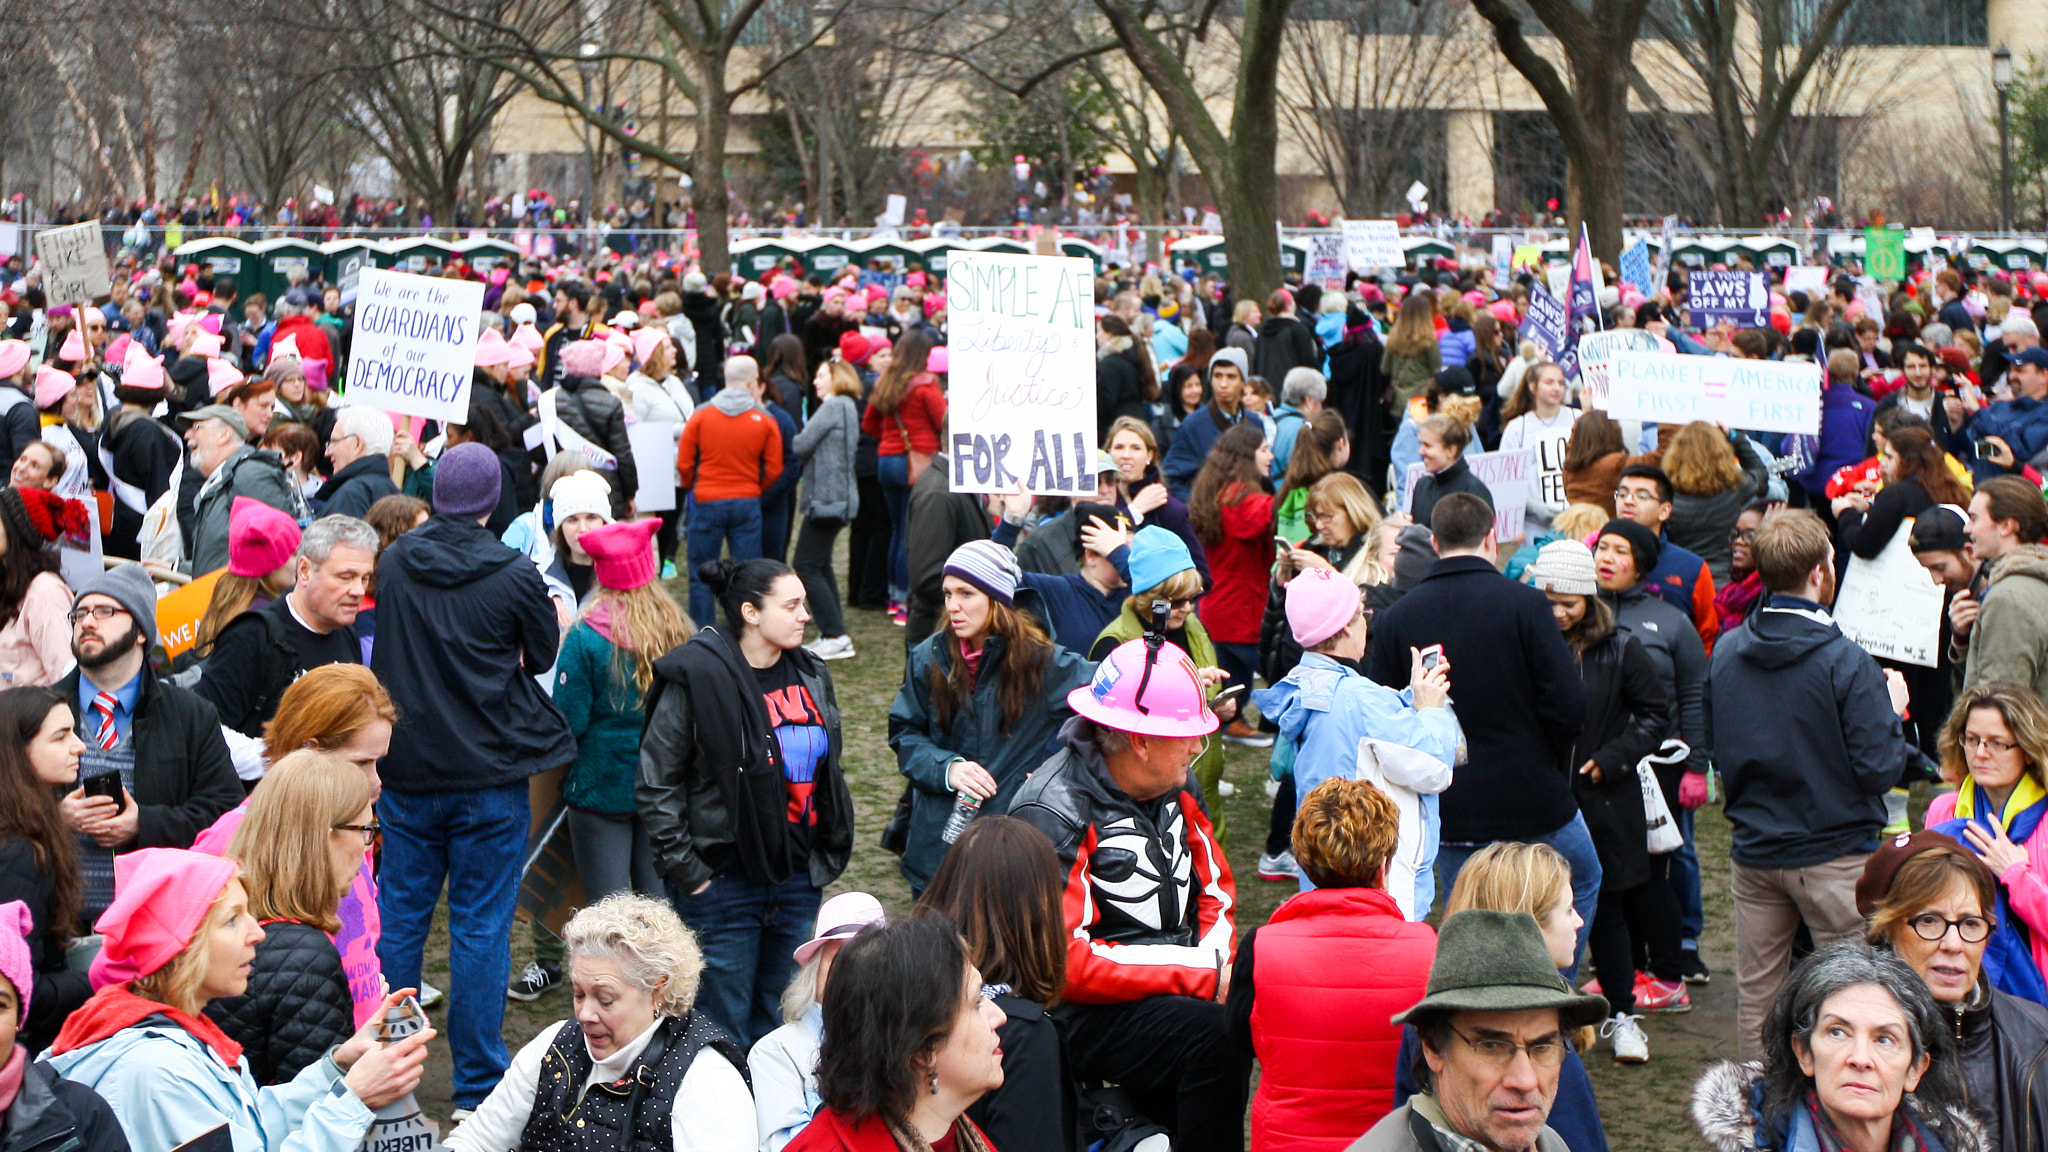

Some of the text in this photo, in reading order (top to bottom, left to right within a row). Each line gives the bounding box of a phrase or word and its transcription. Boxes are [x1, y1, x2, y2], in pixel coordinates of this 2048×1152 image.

[41, 225, 94, 253] FIGHT
[45, 244, 88, 270] LIKE
[50, 268, 64, 289] A
[1690, 271, 1746, 281] KEEP YOUR
[1690, 280, 1746, 297] LAWS
[51, 278, 95, 305] GIRL
[374, 279, 392, 296] We
[398, 288, 420, 301] are
[428, 286, 449, 305] the
[1048, 267, 1092, 329] AF
[1691, 297, 1746, 309] OFF MY
[1528, 306, 1546, 324] OFF
[1531, 289, 1565, 325] LAWS
[361, 303, 468, 345] GUARDIANS
[383, 341, 428, 364] of our
[957, 316, 1061, 378] Liberty
[353, 357, 465, 403] DEMOCRACY
[1617, 359, 1706, 383] PLANET
[1731, 366, 1818, 394] AMERICA
[971, 362, 1084, 422] Justice
[1637, 390, 1807, 422] FIRST FIRST
[953, 429, 1096, 491] FOR ALL
[1540, 437, 1567, 472] LO
[1541, 474, 1566, 503] FE
[163, 623, 193, 649] WE
